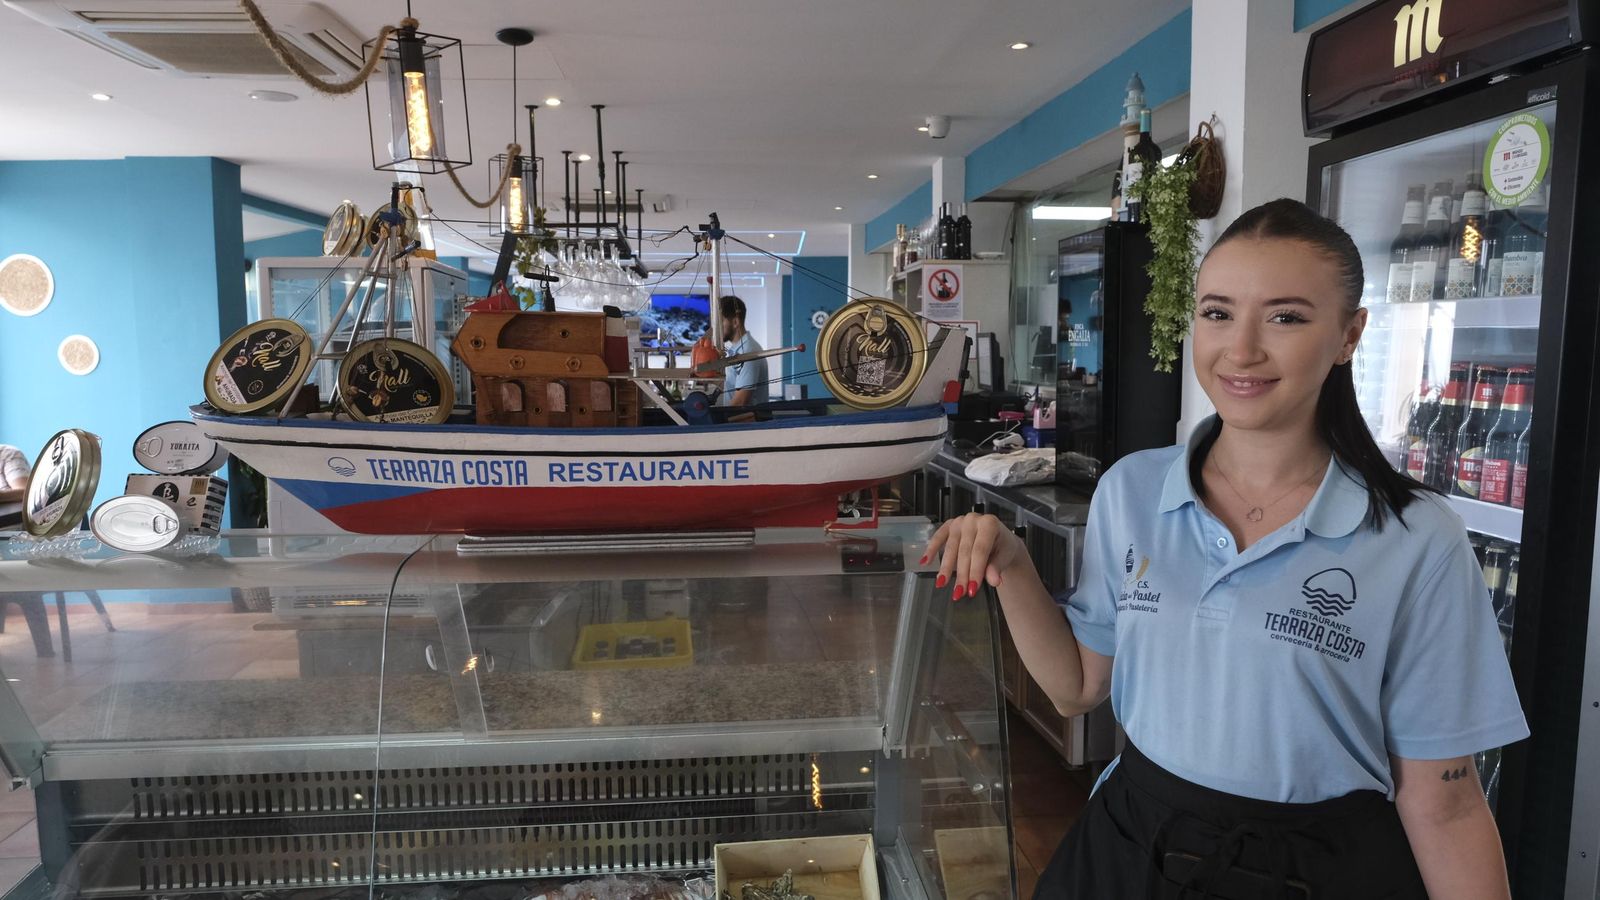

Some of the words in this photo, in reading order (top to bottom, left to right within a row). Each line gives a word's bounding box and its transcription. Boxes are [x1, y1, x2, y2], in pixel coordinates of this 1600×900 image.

[390, 412, 434, 423] MANTEQUILLA
[366, 459, 456, 484] TERRAZA
[462, 460, 528, 485] COSTA
[548, 459, 750, 482] RESTAURANTE
[1289, 607, 1352, 635] RESTAURANTE
[1264, 612, 1325, 644] TERRAZA
[1325, 629, 1366, 660] COSTA
